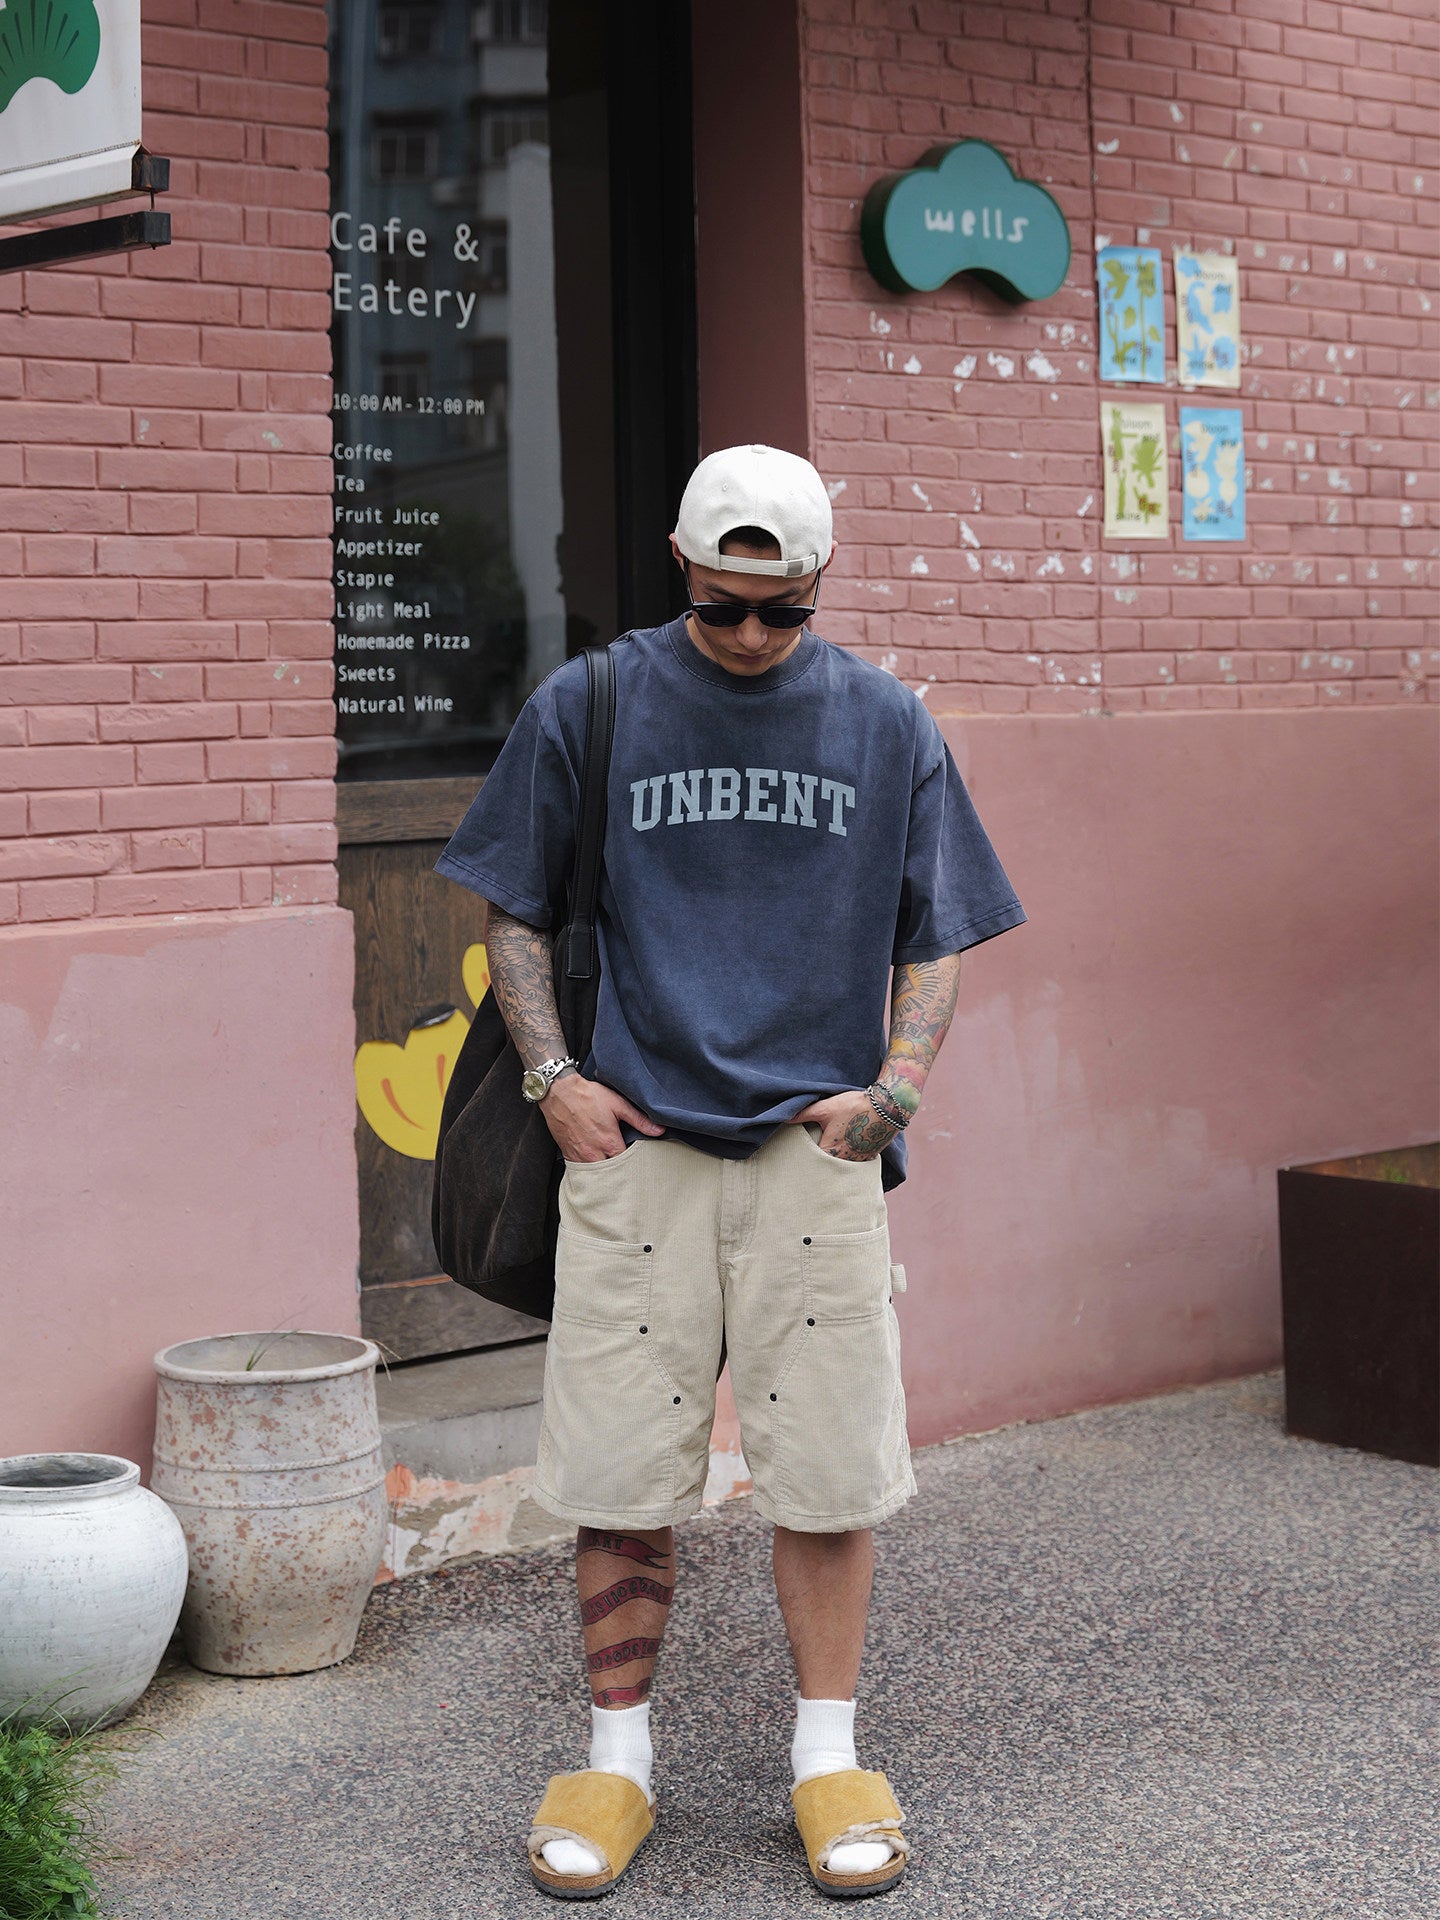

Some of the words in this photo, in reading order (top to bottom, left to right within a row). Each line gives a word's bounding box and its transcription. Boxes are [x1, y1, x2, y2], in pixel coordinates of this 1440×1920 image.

[924, 207, 1030, 243] wells
[330, 211, 428, 258] Cafe
[453, 223, 480, 262] &
[333, 272, 477, 330] Eatery
[333, 393, 380, 412] 10:00
[381, 395, 403, 412] AM
[417, 396, 463, 415] 12:00
[465, 398, 486, 415] PM
[334, 442, 393, 462] Coffee
[335, 474, 366, 493] Tea
[335, 506, 384, 524] Fruit
[392, 507, 441, 526] Juice
[336, 538, 424, 559] Appetizer
[336, 601, 385, 623] Light
[393, 601, 432, 619] Meal
[337, 633, 415, 651] Homemade
[423, 632, 472, 650] Pizza
[338, 664, 397, 682] Sweets
[338, 695, 406, 714] Natural
[413, 694, 455, 713] Wine
[629, 767, 856, 837] UNBENT
